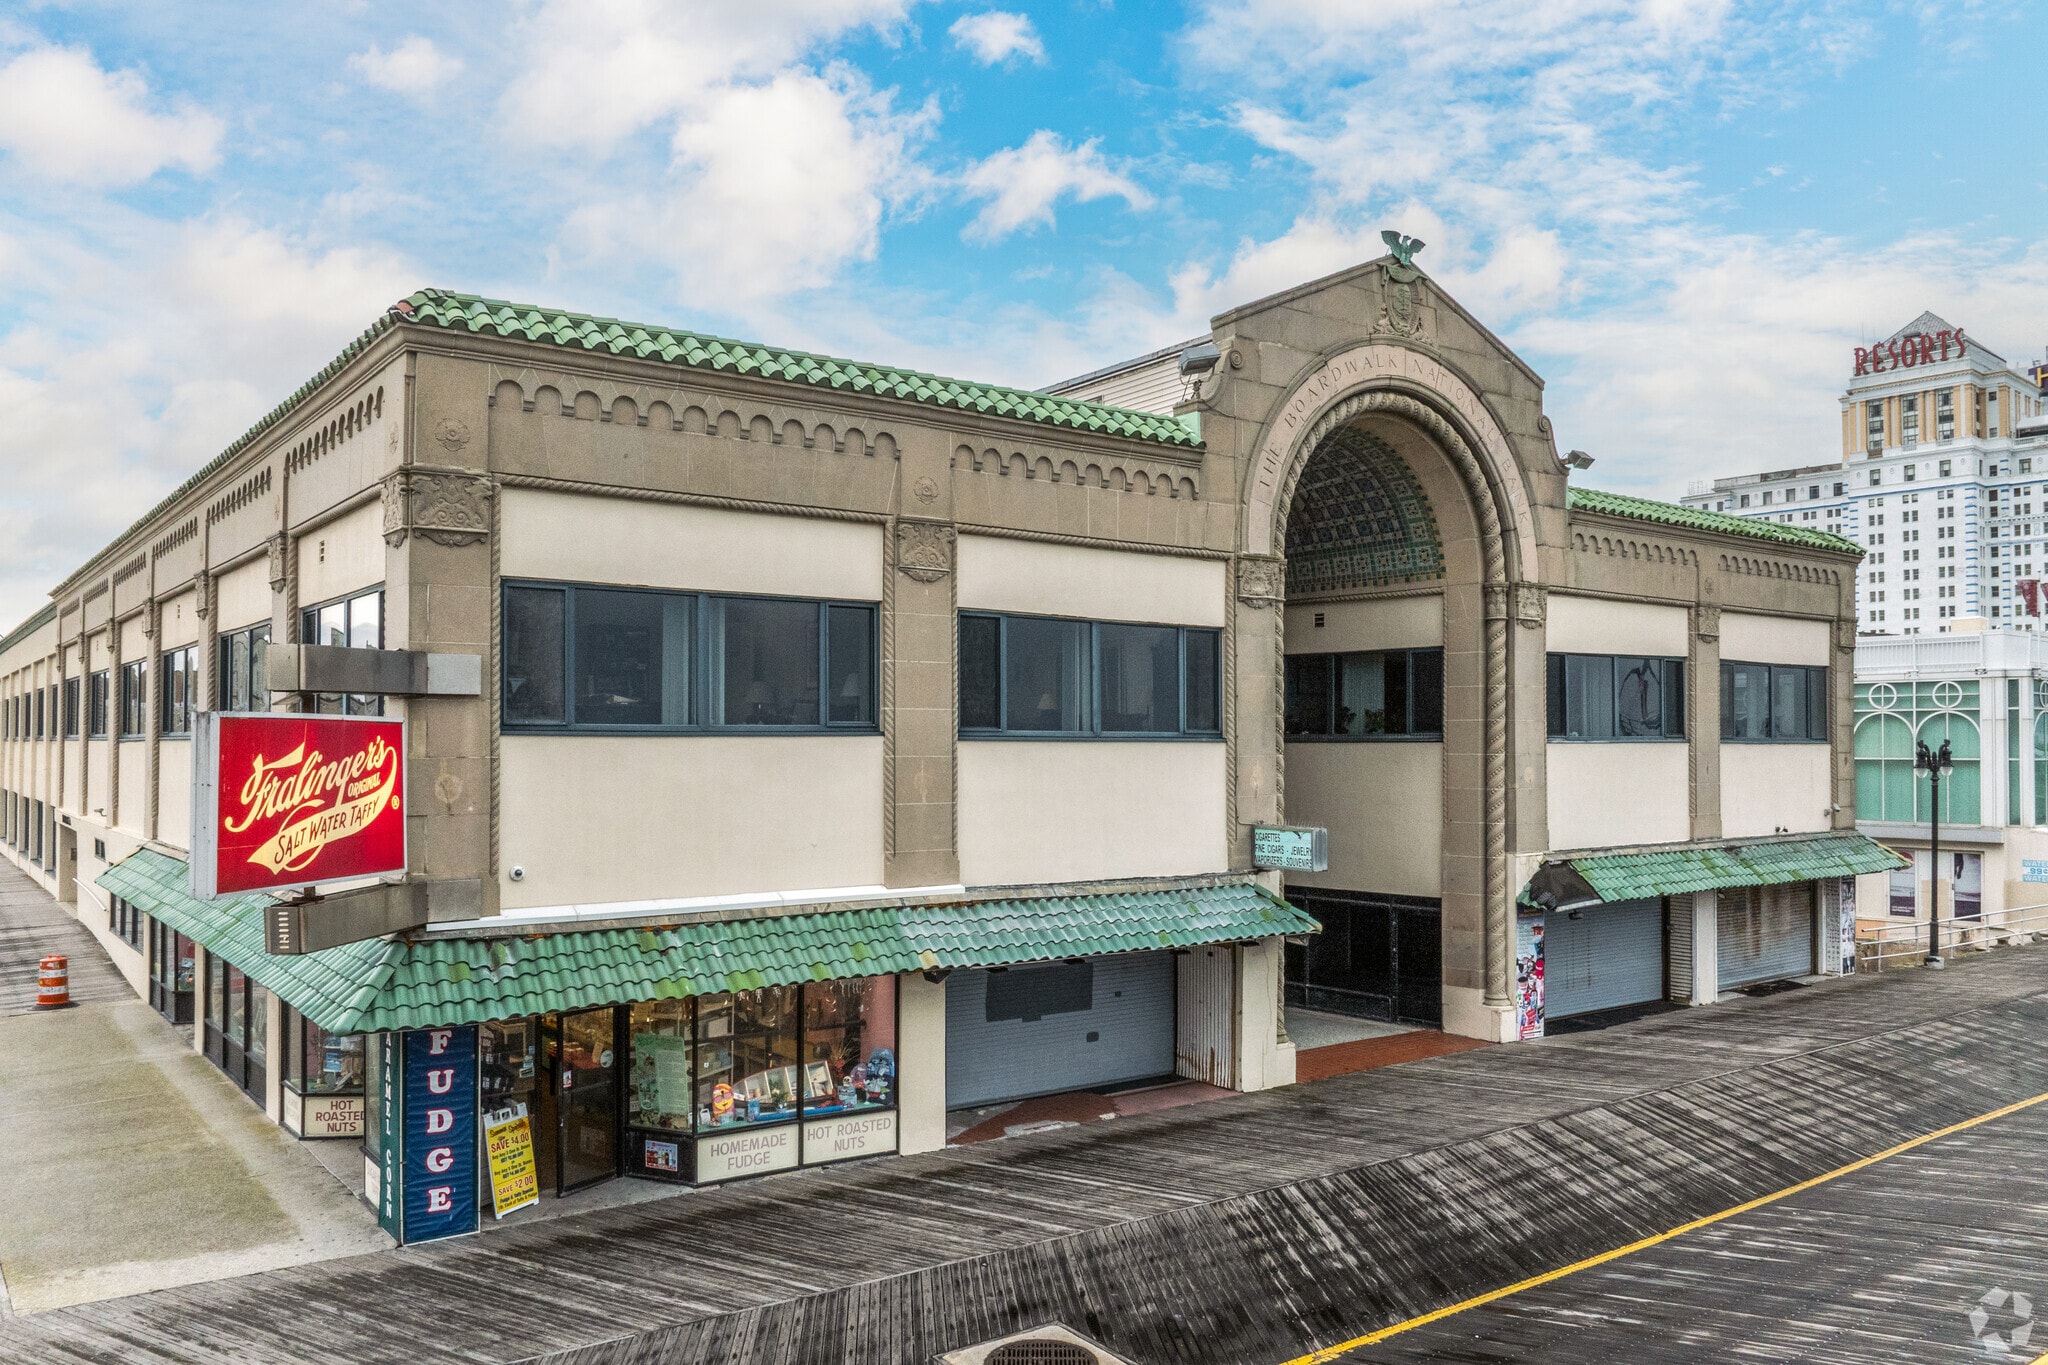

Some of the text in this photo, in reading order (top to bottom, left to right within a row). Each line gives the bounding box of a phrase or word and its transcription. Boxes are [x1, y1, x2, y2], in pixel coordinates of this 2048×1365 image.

[1854, 327, 1966, 376] RESORTS
[1258, 354, 1529, 524] THE BOARDWALK NATIONAL BANK
[347, 771, 381, 798] ORIGINAL
[274, 796, 380, 865] SALT WATER TAFFY
[1267, 844, 1285, 854] CIGARS
[384, 1032, 392, 1136] ARAMEL
[330, 1100, 354, 1111] HOT
[327, 1122, 357, 1133] NUTS
[426, 1030, 454, 1213] FUDGE
[807, 1117, 892, 1141] HOT ROASTED
[491, 1140, 510, 1153] SAVE
[710, 1133, 787, 1158] HOMEMADE
[834, 1137, 865, 1152] NUTS
[727, 1152, 771, 1170] FUDGE
[498, 1185, 513, 1196] SAVE
